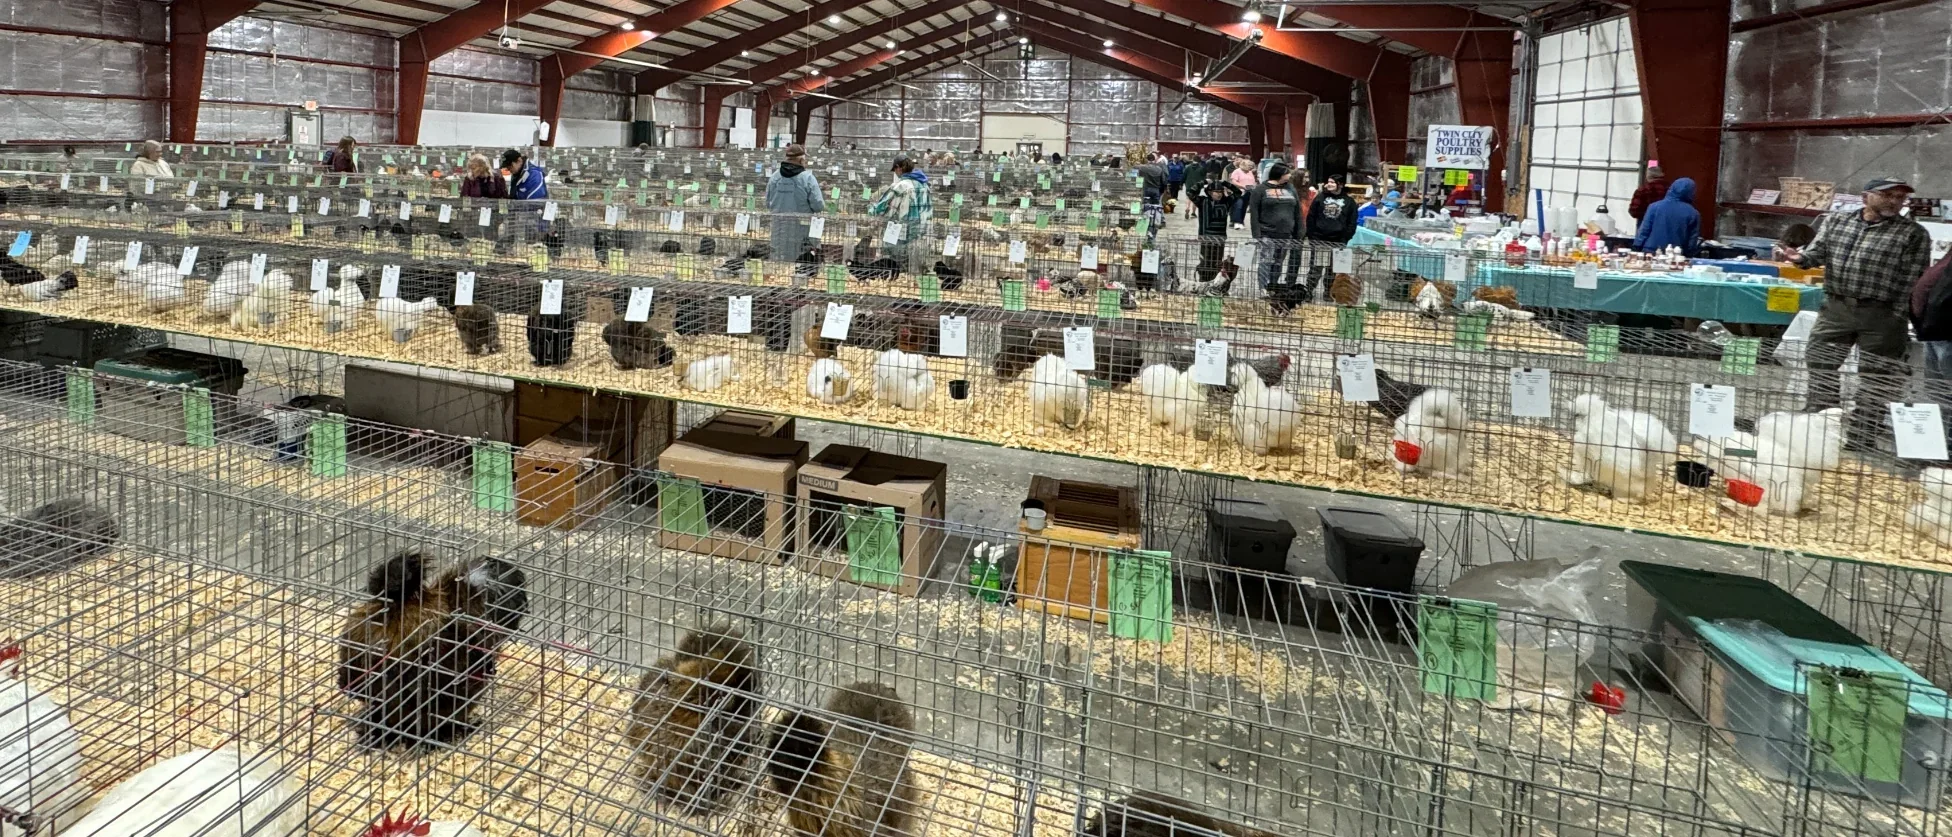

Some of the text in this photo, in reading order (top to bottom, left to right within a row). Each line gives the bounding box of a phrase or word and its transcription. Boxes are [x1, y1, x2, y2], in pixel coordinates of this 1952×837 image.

[1437, 129, 1483, 138] TWIN CITY
[1436, 137, 1484, 148] POULTRY
[1435, 146, 1482, 156] SUPPLIES
[801, 475, 836, 490] MEDIUM
